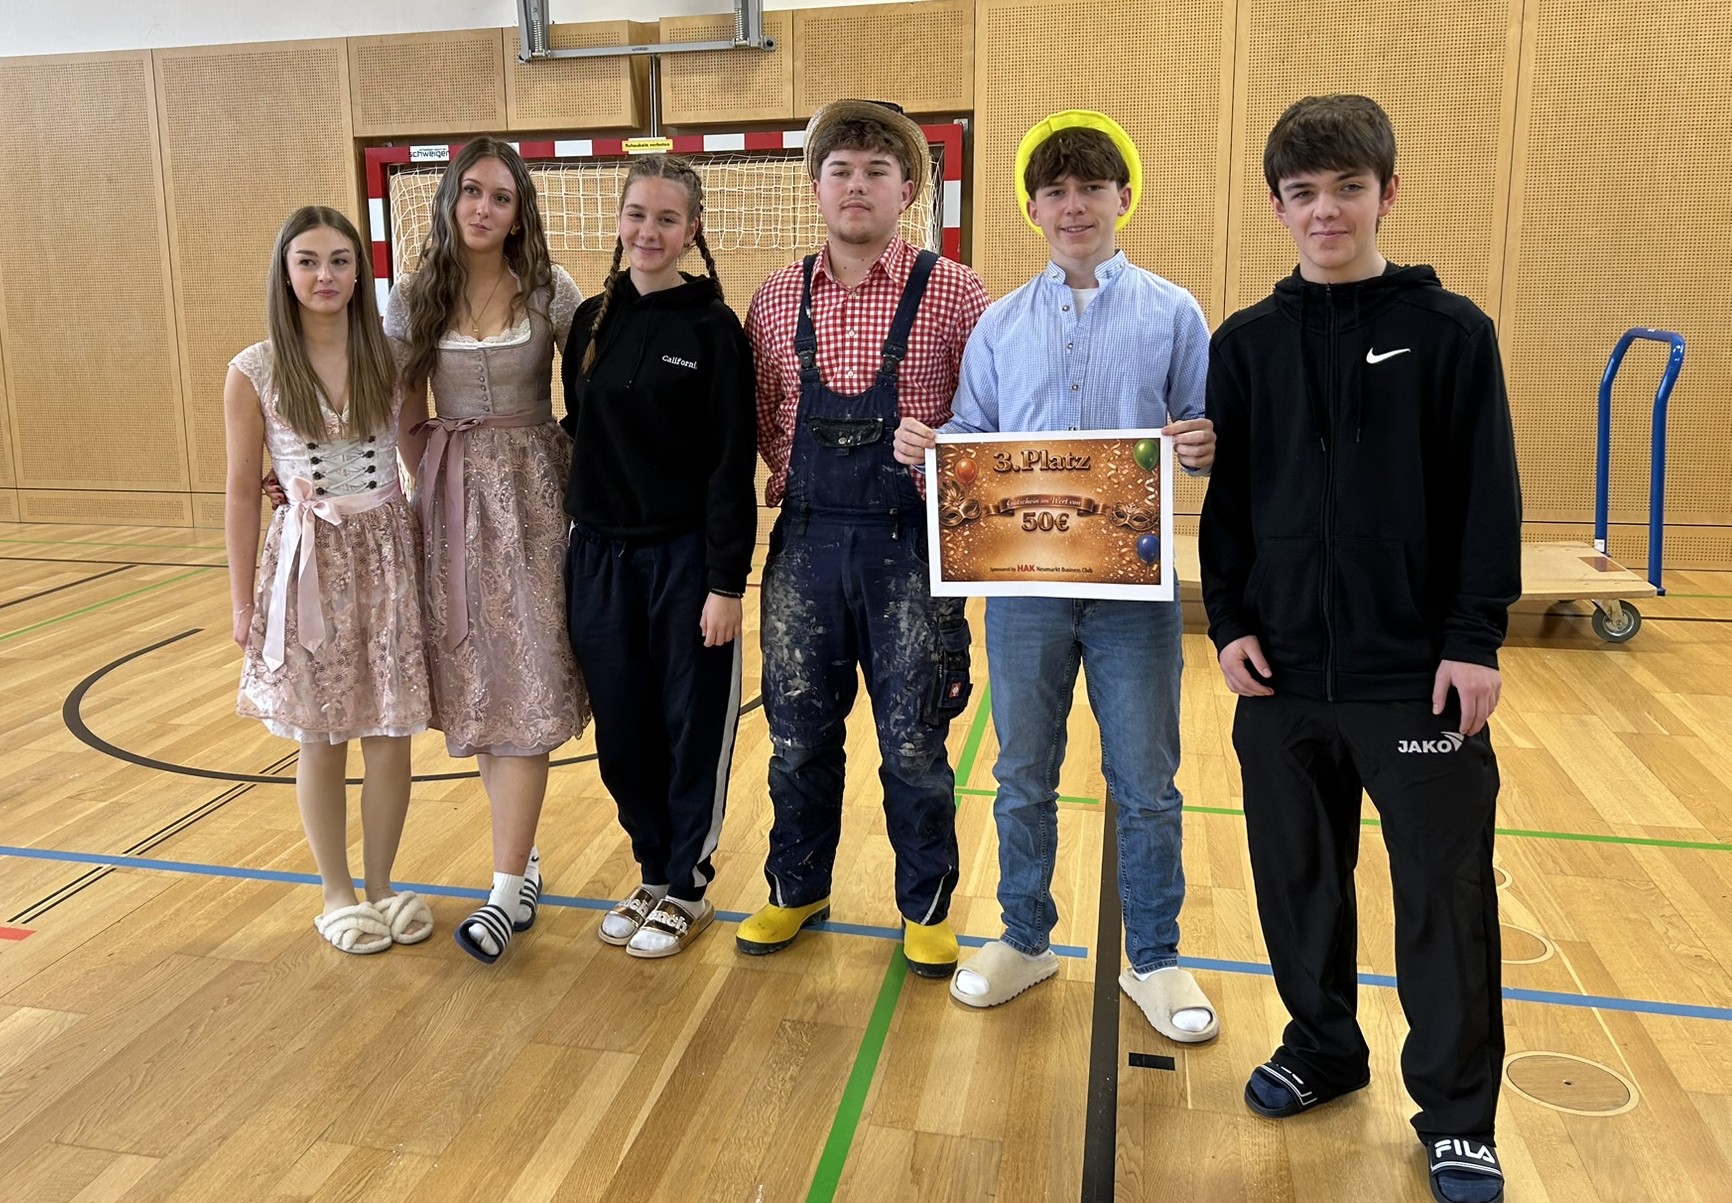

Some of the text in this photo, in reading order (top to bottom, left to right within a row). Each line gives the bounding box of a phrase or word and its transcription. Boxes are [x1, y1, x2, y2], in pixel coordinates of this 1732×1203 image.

[661, 354, 698, 370] Californi
[993, 449, 1091, 472] 3.Platz
[1021, 511, 1070, 532] 50€
[1017, 564, 1035, 572] HAK
[1397, 740, 1453, 753] JAKO
[1434, 1139, 1496, 1164] FILA
